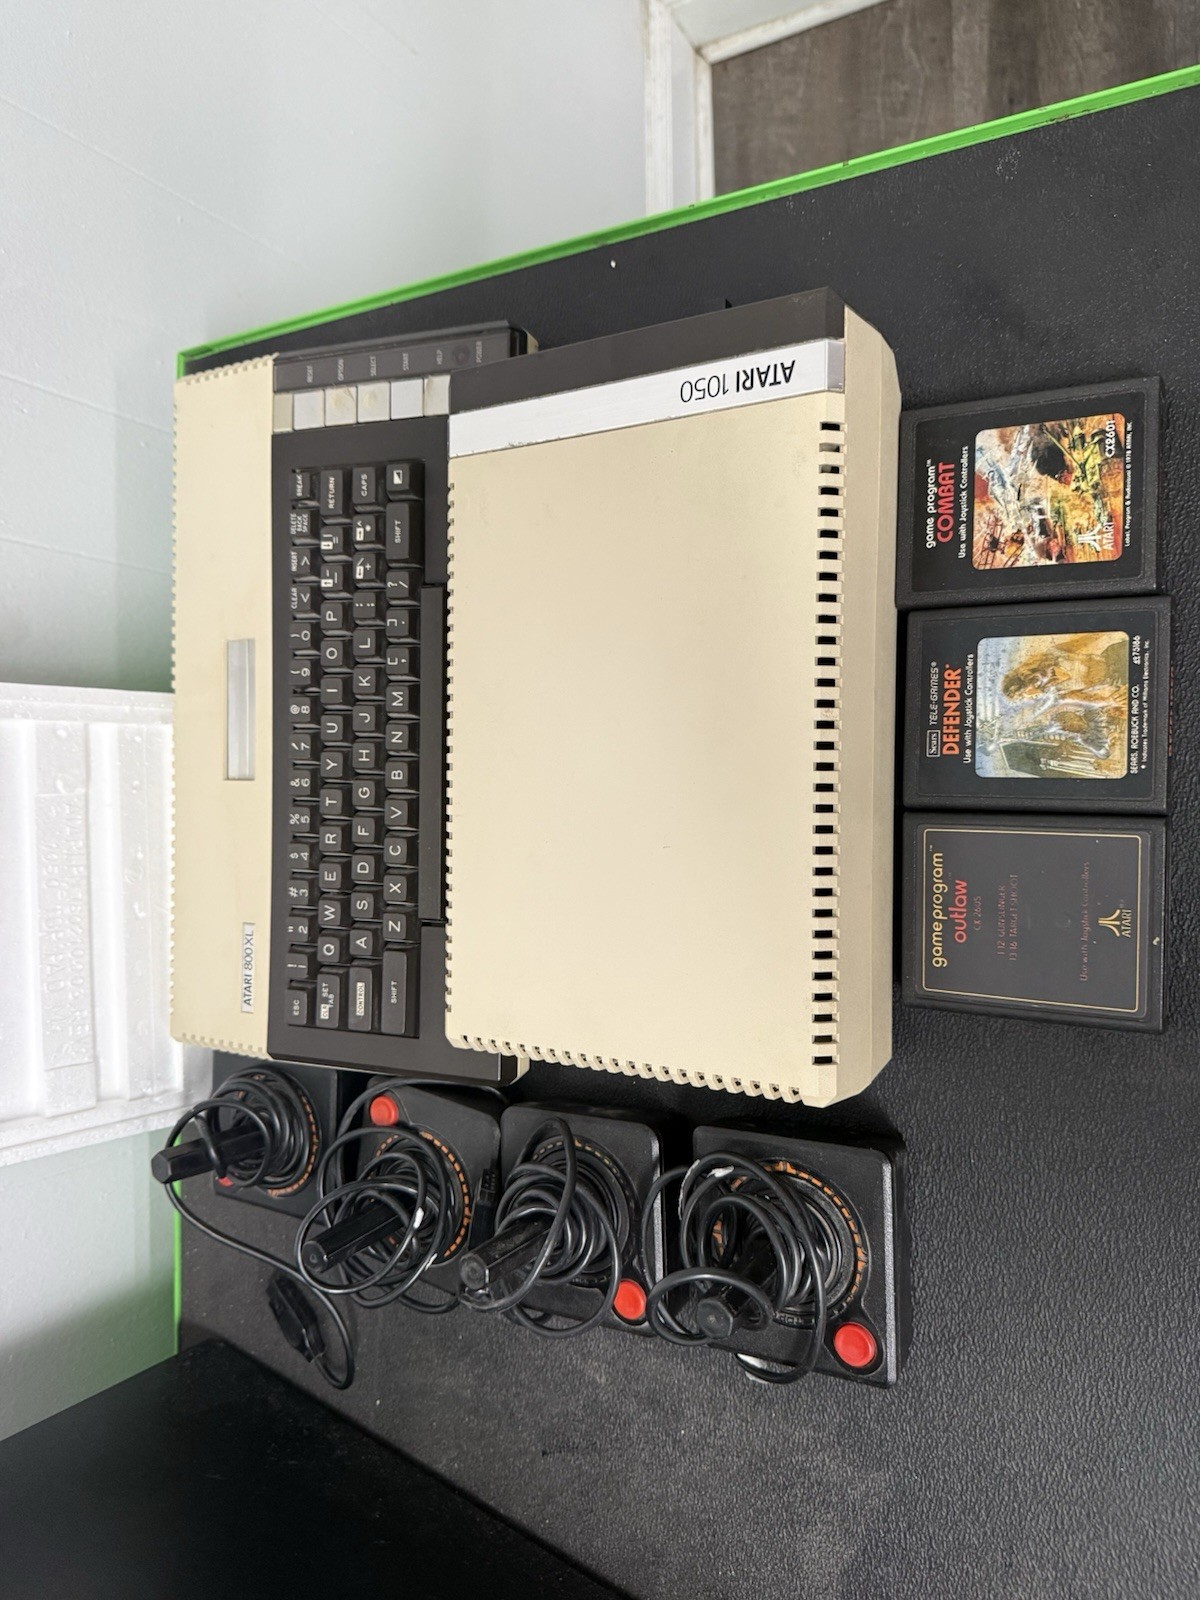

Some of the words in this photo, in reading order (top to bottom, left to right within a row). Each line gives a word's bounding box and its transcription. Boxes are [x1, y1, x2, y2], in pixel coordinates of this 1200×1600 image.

[736, 359, 796, 393] ATARI
[680, 373, 729, 403] 1050
[1105, 420, 1116, 458] CX2601
[960, 446, 969, 489] Controllers
[937, 462, 954, 542] COMBAT
[960, 490, 969, 522] Joystick
[926, 517, 936, 548] game
[958, 524, 967, 540] with
[1102, 521, 1114, 550] ATARI
[958, 543, 966, 558] Use
[326, 610, 338, 622] P
[358, 637, 371, 648] L
[326, 647, 338, 660] O
[302, 667, 310, 676] 9
[964, 654, 974, 696] Controllers
[358, 675, 371, 686] K
[1132, 683, 1140, 698] CO.
[392, 691, 404, 706] M
[290, 704, 300, 714] @
[302, 705, 310, 714] 8
[1131, 699, 1140, 714] AND
[358, 712, 371, 724] J
[964, 698, 975, 728] Joystick
[326, 722, 338, 734] U
[1130, 716, 1139, 750] ROEBUCK
[392, 731, 404, 743] N
[928, 732, 938, 754] Sears
[964, 730, 972, 746] with
[302, 742, 310, 750] 7
[358, 750, 370, 762] H
[963, 748, 972, 764] Use
[326, 758, 338, 770] Y
[391, 769, 404, 780] B
[302, 778, 310, 787] 6
[358, 786, 370, 798] G
[326, 796, 338, 806] T
[390, 806, 402, 818] V
[302, 815, 310, 824] 5
[358, 825, 370, 836] F
[326, 832, 336, 844] R
[302, 851, 310, 860] 4
[390, 844, 402, 856] C
[357, 862, 369, 874] D
[324, 871, 336, 882] E
[300, 888, 309, 896] 3
[389, 882, 401, 894] X
[356, 899, 368, 910] S
[324, 904, 336, 921] W
[948, 879, 968, 944] outlaw
[388, 919, 400, 932] Z
[1122, 908, 1132, 938] ATARI
[300, 925, 308, 934] 2
[356, 936, 368, 948] A
[932, 921, 948, 968] game
[323, 943, 335, 956] Q
[243, 974, 252, 1006] ATARI
